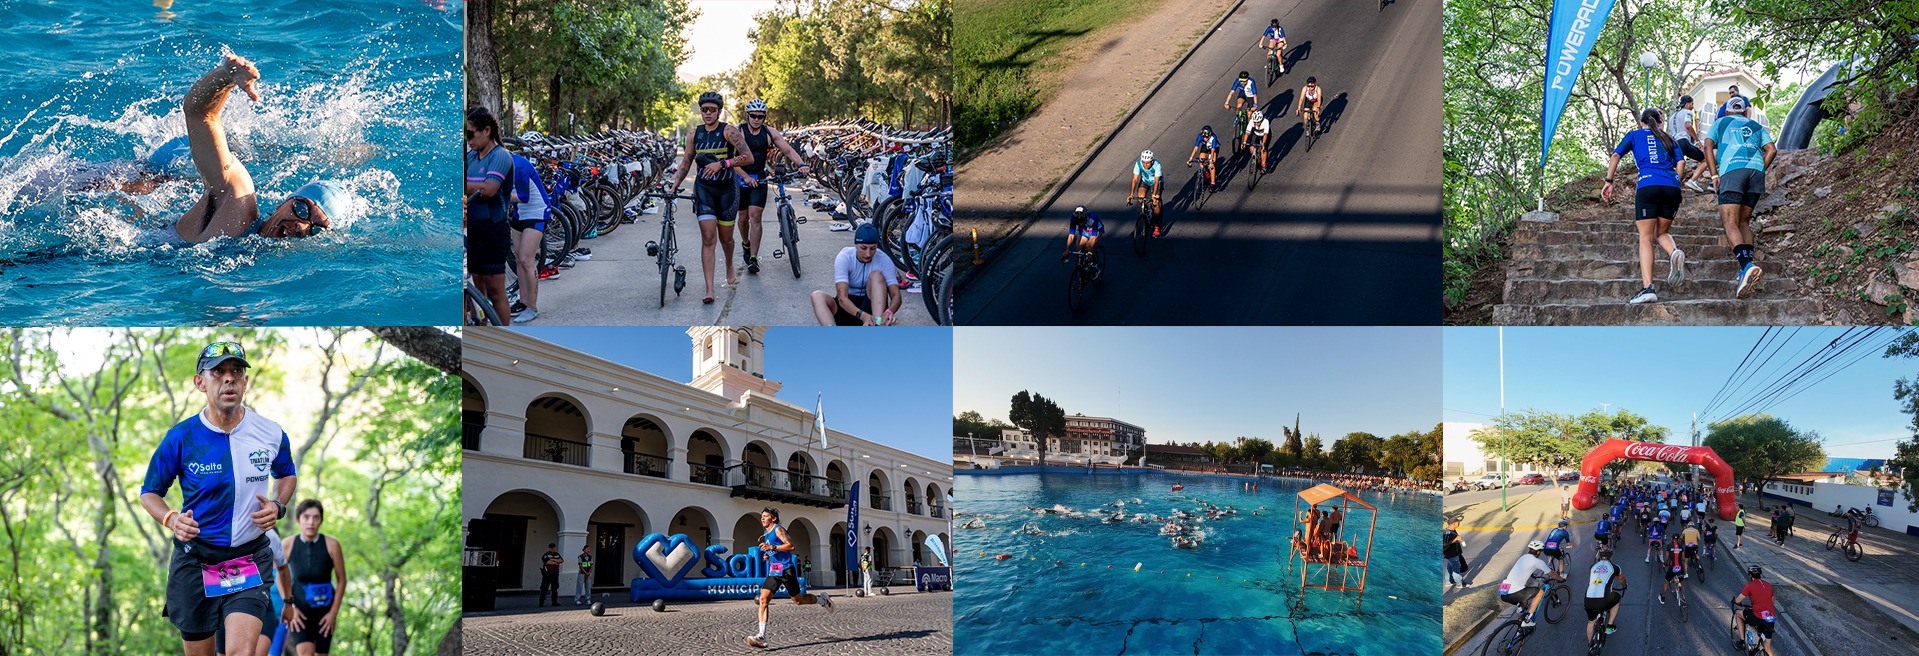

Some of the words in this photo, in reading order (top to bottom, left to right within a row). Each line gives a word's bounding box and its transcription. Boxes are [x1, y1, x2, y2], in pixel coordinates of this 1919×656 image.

[1624, 442, 1689, 463] Coca-Cola
[200, 462, 222, 471] Salta
[701, 543, 798, 578] Sal
[931, 572, 948, 583] Macro
